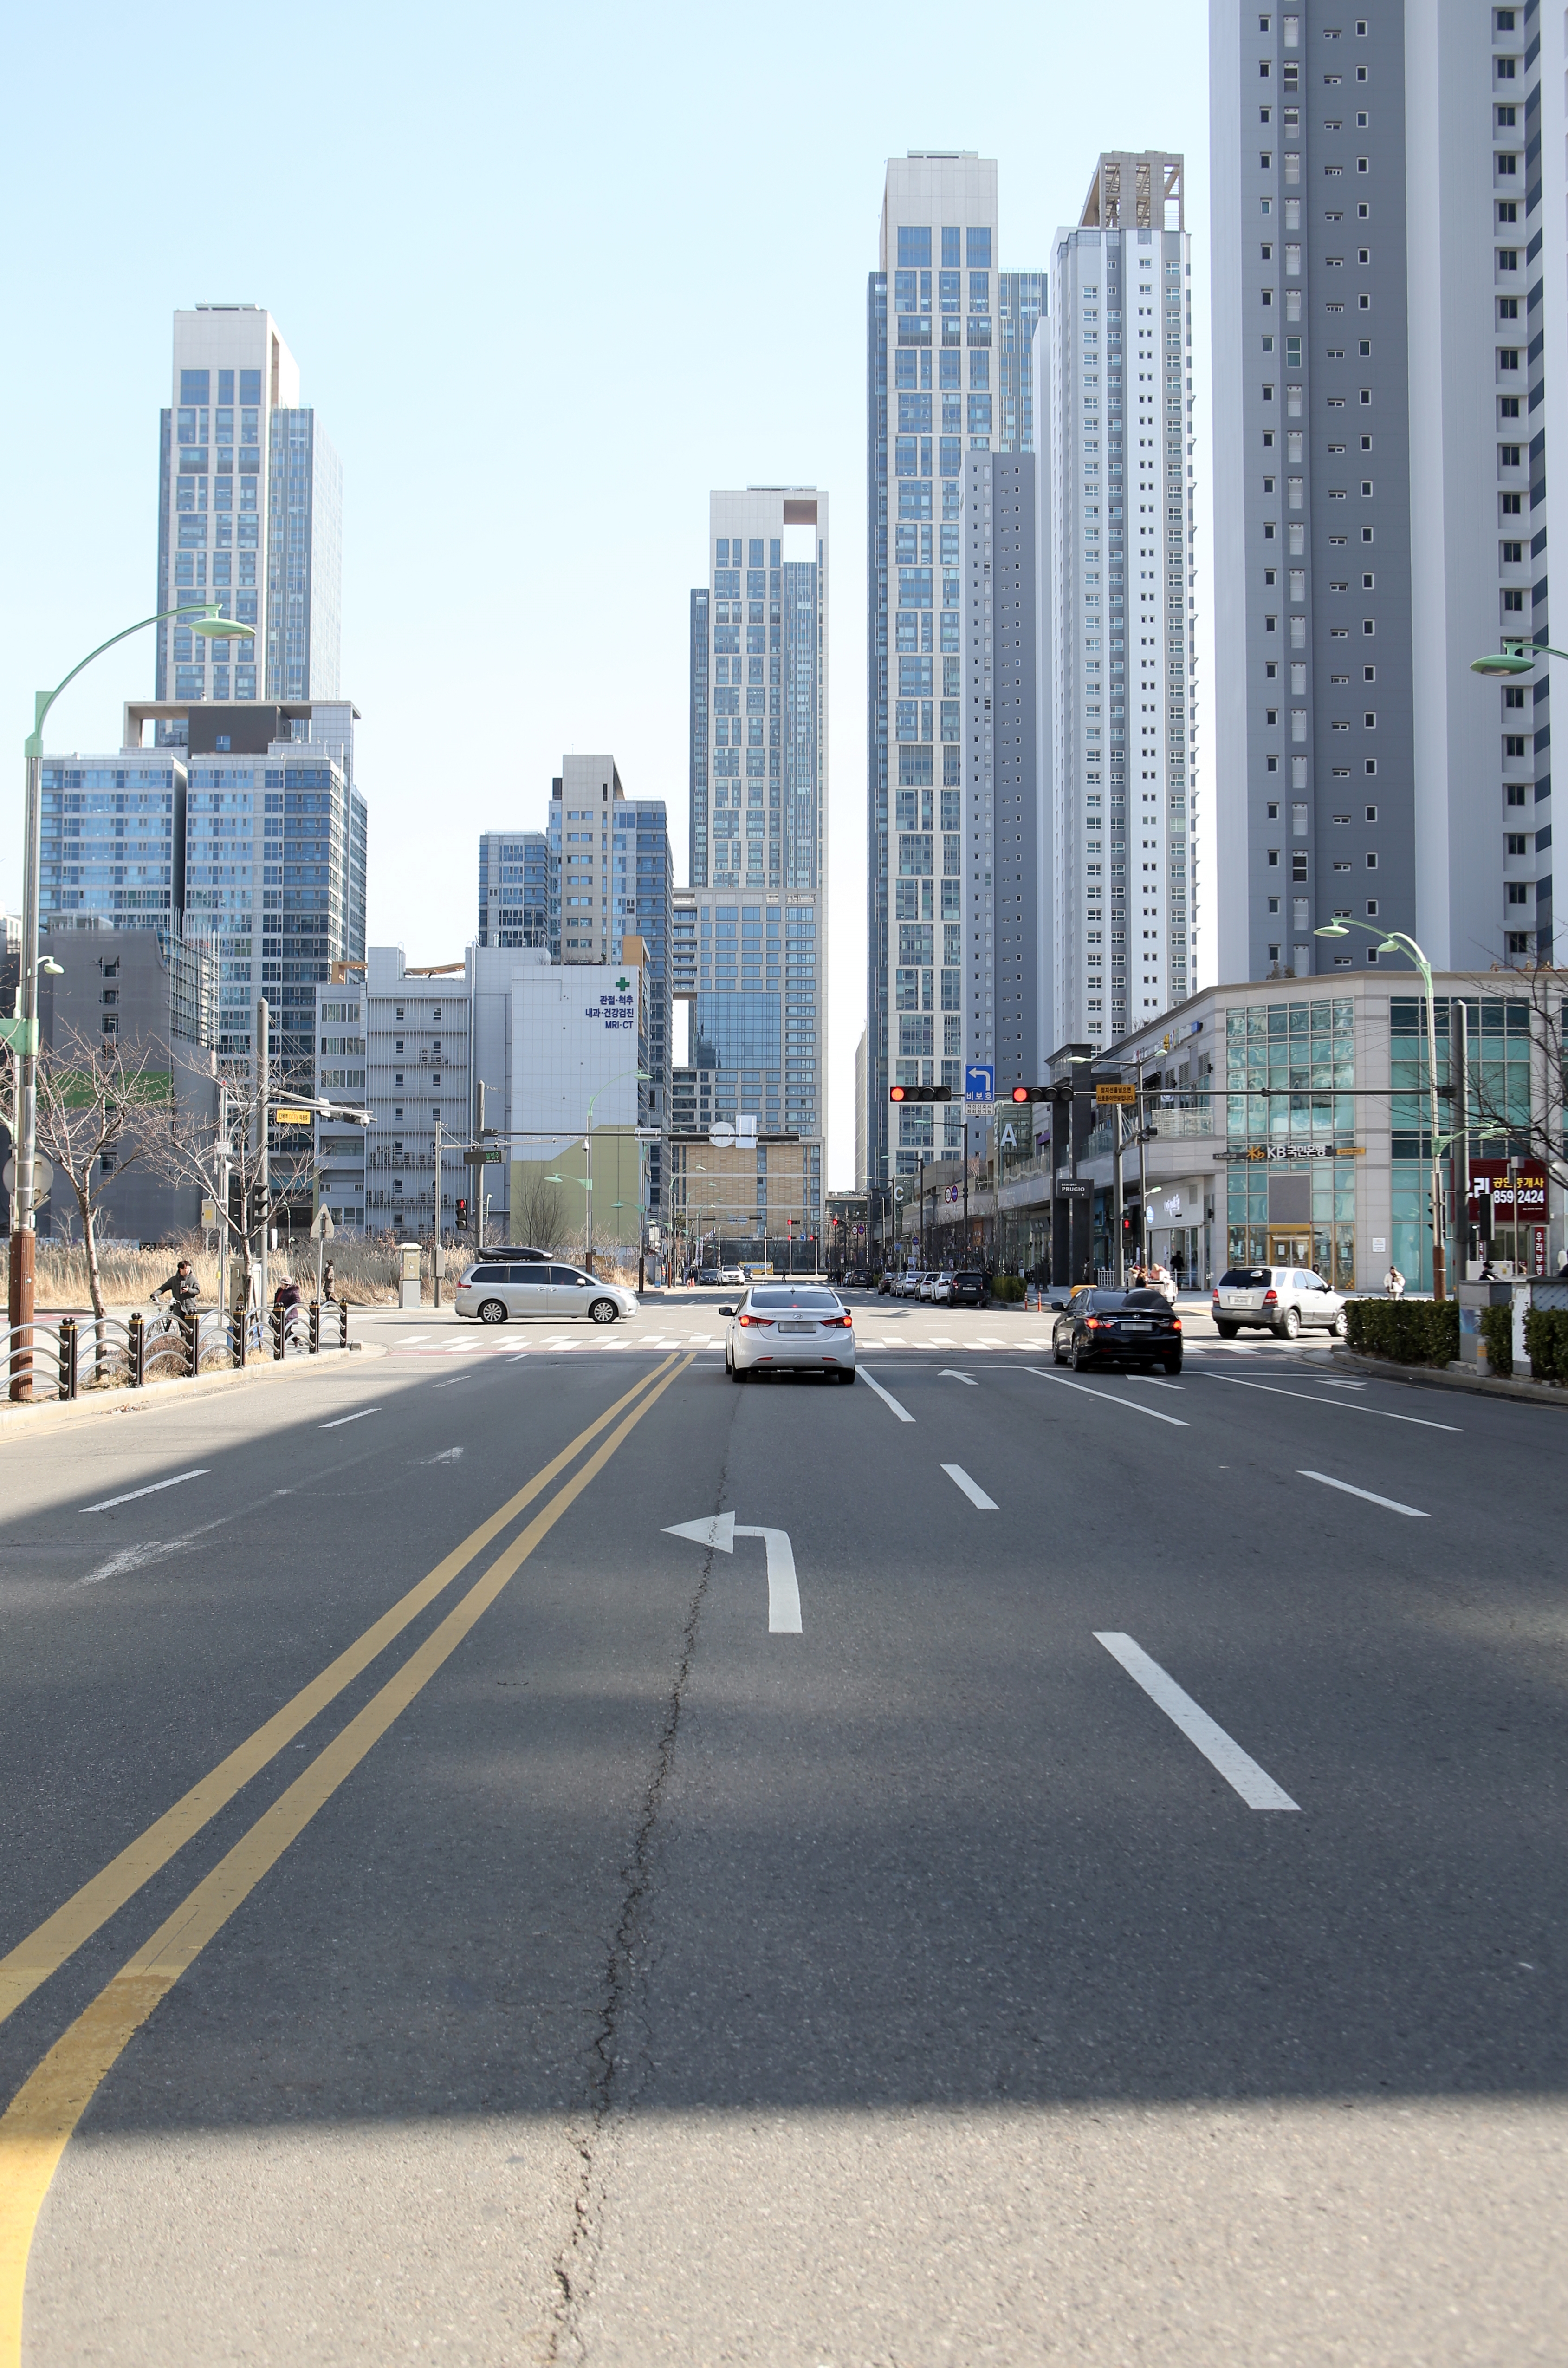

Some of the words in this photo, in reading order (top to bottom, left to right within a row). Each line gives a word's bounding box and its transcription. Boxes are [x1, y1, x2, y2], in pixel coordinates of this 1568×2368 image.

[600, 995, 634, 1005] 관절·척추
[585, 1008, 634, 1018] 내과·건강검진
[605, 1021, 634, 1029] MRI·CT
[966, 1091, 992, 1100] 비보호
[1000, 1123, 1017, 1146] A
[1268, 1145, 1327, 1158] KB국민은행
[1493, 1177, 1544, 1188] 공인중개사
[895, 1186, 904, 1201] C
